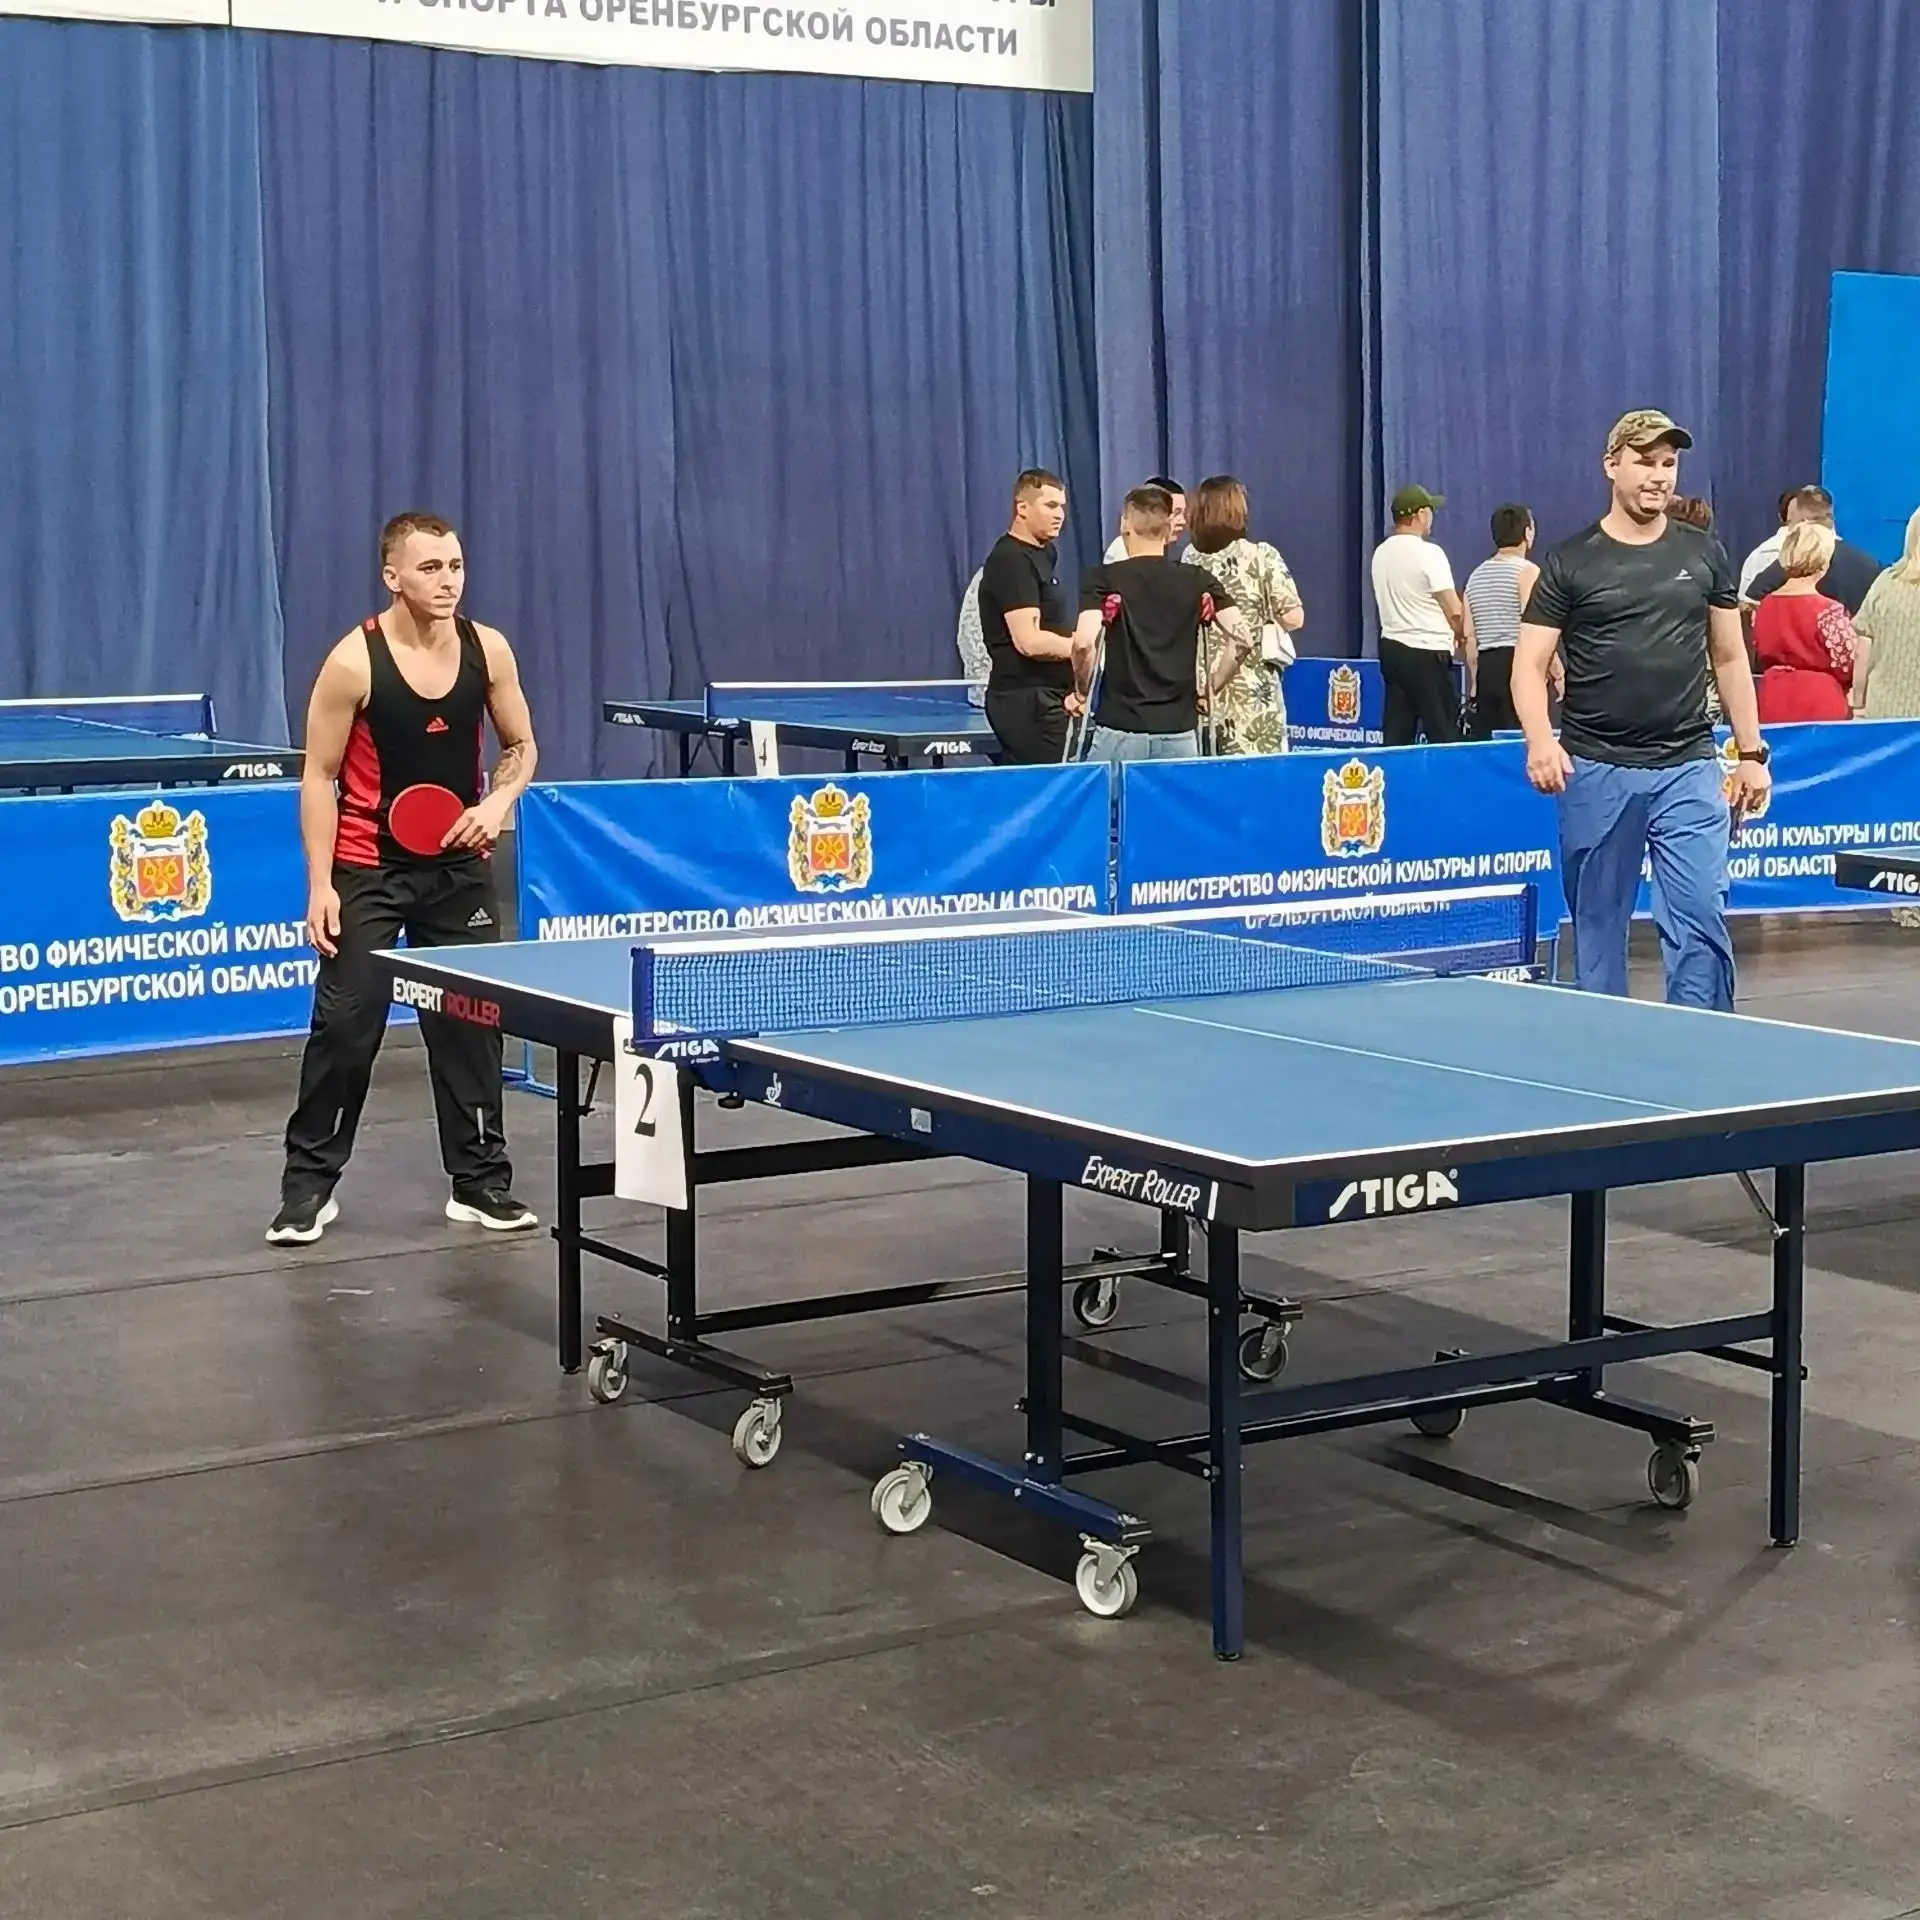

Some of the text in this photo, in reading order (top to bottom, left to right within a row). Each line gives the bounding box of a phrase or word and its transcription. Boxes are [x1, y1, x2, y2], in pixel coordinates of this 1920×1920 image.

[580, 0, 853, 42] ОРЕНБУРГСКОЙ
[865, 16, 1018, 56] ОБЛАСТИ
[223, 763, 283, 778] STIGA
[924, 741, 971, 755] STIGA
[1782, 823, 1870, 847] КУЛЬТУРЫ
[1873, 822, 1887, 844] И
[1131, 849, 1552, 906] МИНИСТЕРСТВО ФИЗИЧЕСКОЙ КУЛЬТУРЫ И СПОРТА
[538, 884, 1098, 941] МИНИСТЕРСТВО ФИЗИЧЕСКОЙ КУЛЬТУРЫ И СПОРТА
[0, 942, 40, 973] ВО
[46, 921, 228, 968] ФИЗИЧЕСКОЙ
[0, 960, 321, 1014] ОРЕНБУРГСКОЙ ОБЛАСТИ
[393, 976, 501, 1028] EXPERT ROLLER
[654, 1038, 720, 1060] STIGA
[633, 1063, 656, 1137] 2
[1329, 1170, 1459, 1220] STIGA
